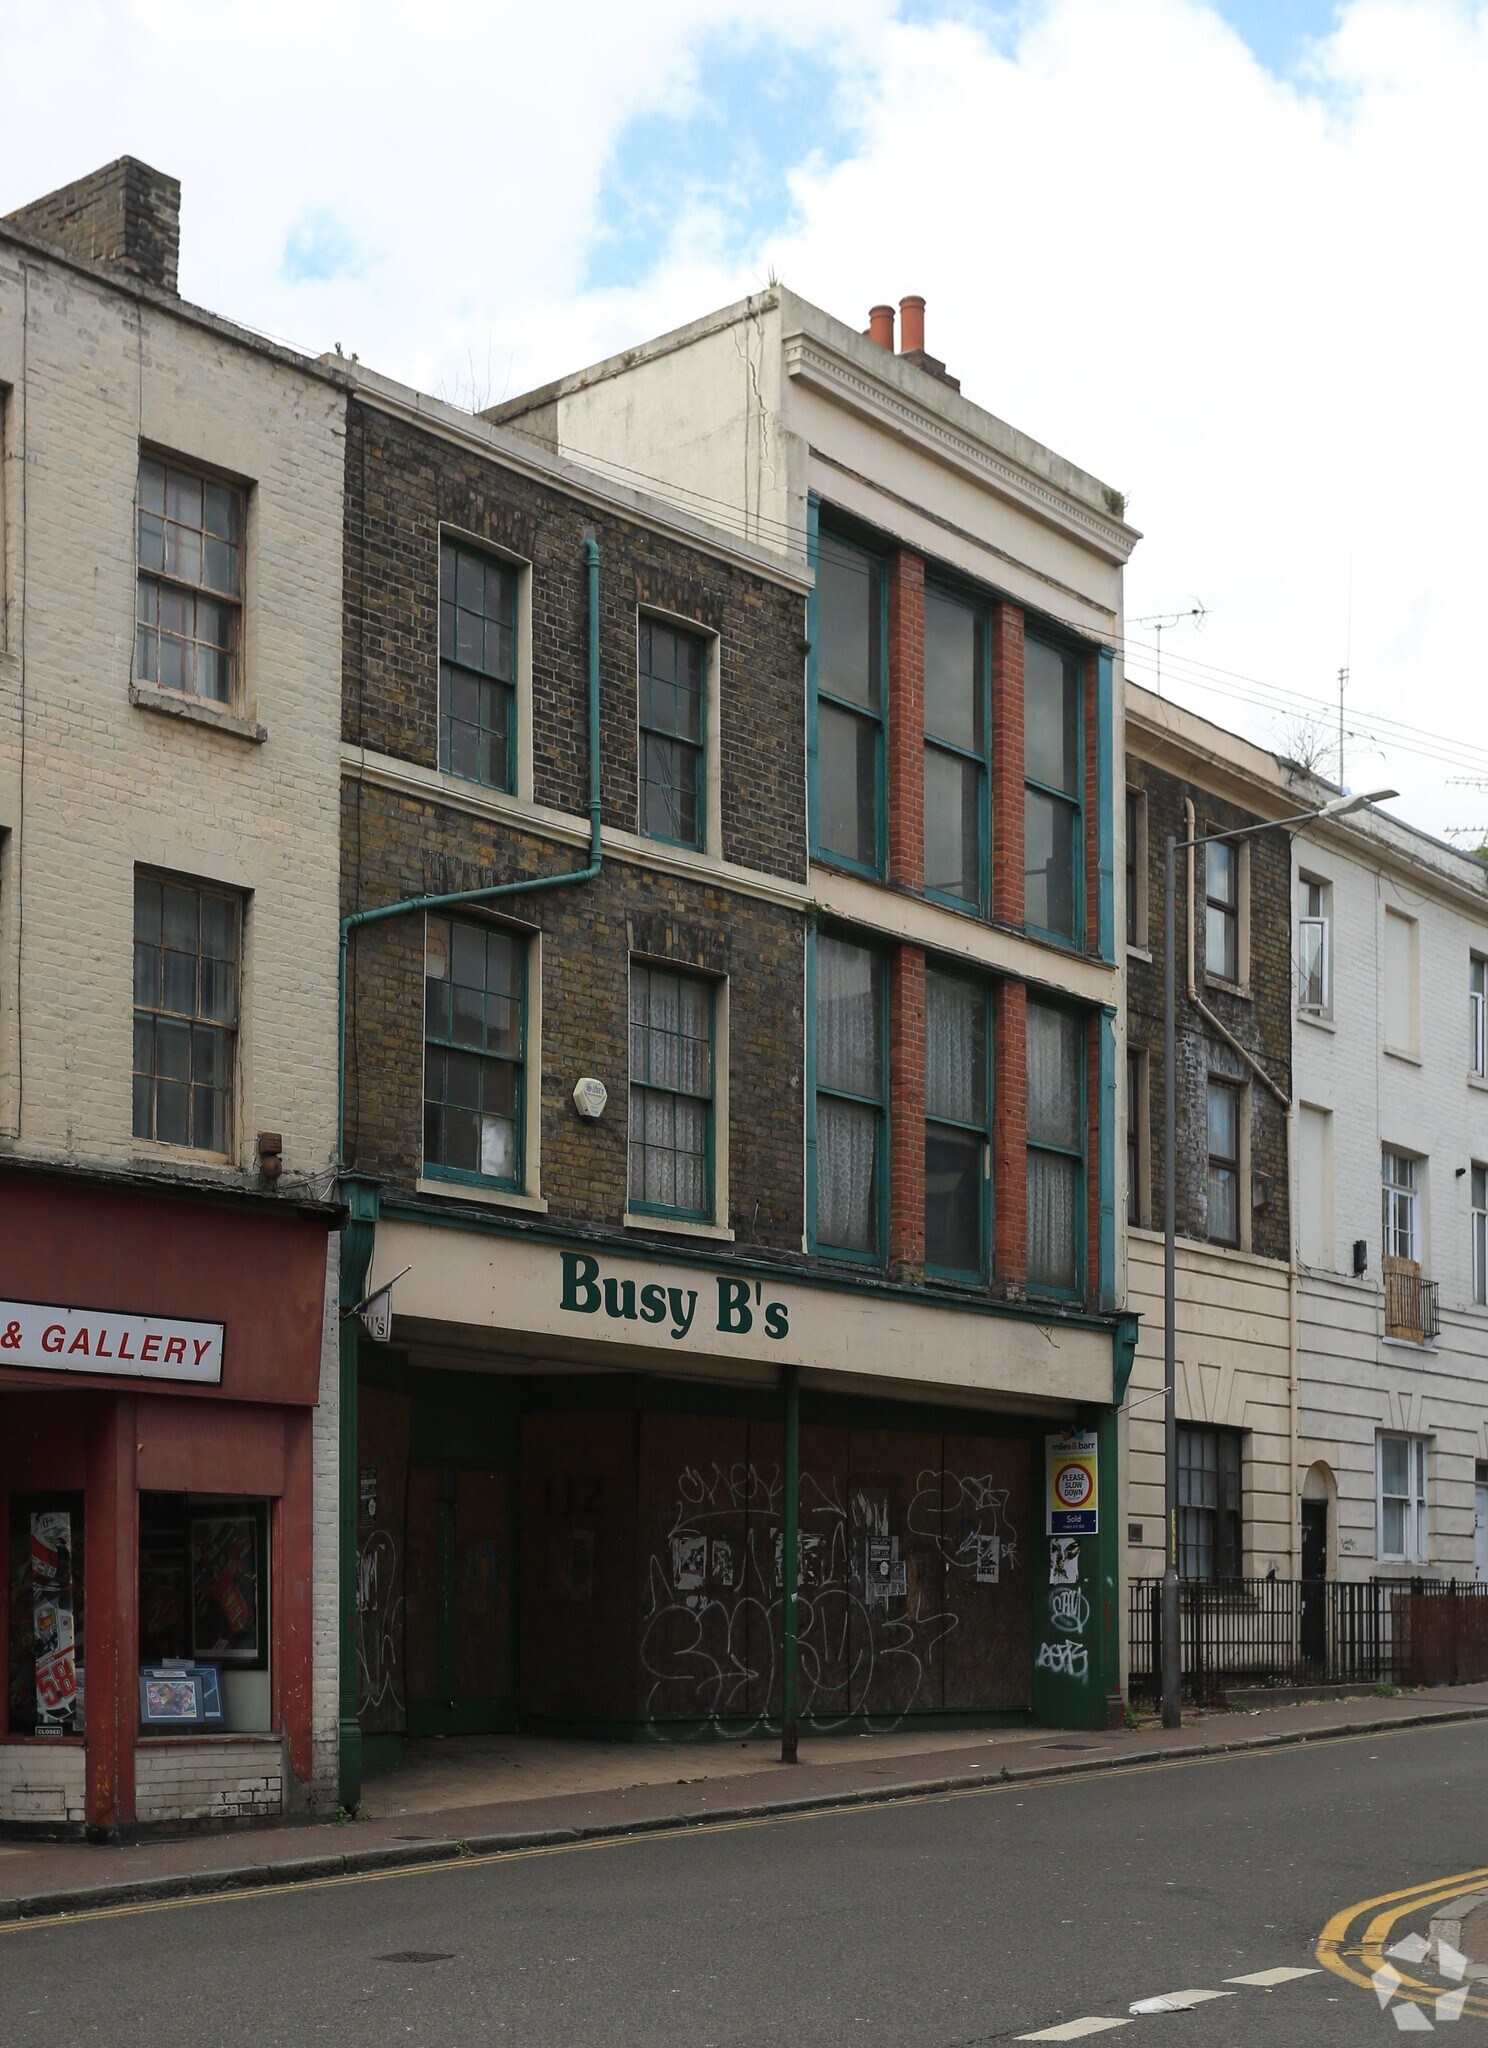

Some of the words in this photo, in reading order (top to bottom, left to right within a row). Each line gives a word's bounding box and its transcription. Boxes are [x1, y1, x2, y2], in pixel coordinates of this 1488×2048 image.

[585, 1082, 605, 1096] Sabre
[560, 1251, 698, 1339] Busy
[716, 1276, 789, 1340] B's
[0, 1320, 23, 1349] &
[41, 1324, 213, 1366] GALLERY
[1062, 1473, 1085, 1481] PLEASE
[1065, 1481, 1083, 1489] SLOW
[1066, 1514, 1082, 1523] Sold
[36, 1659, 76, 1707] 58
